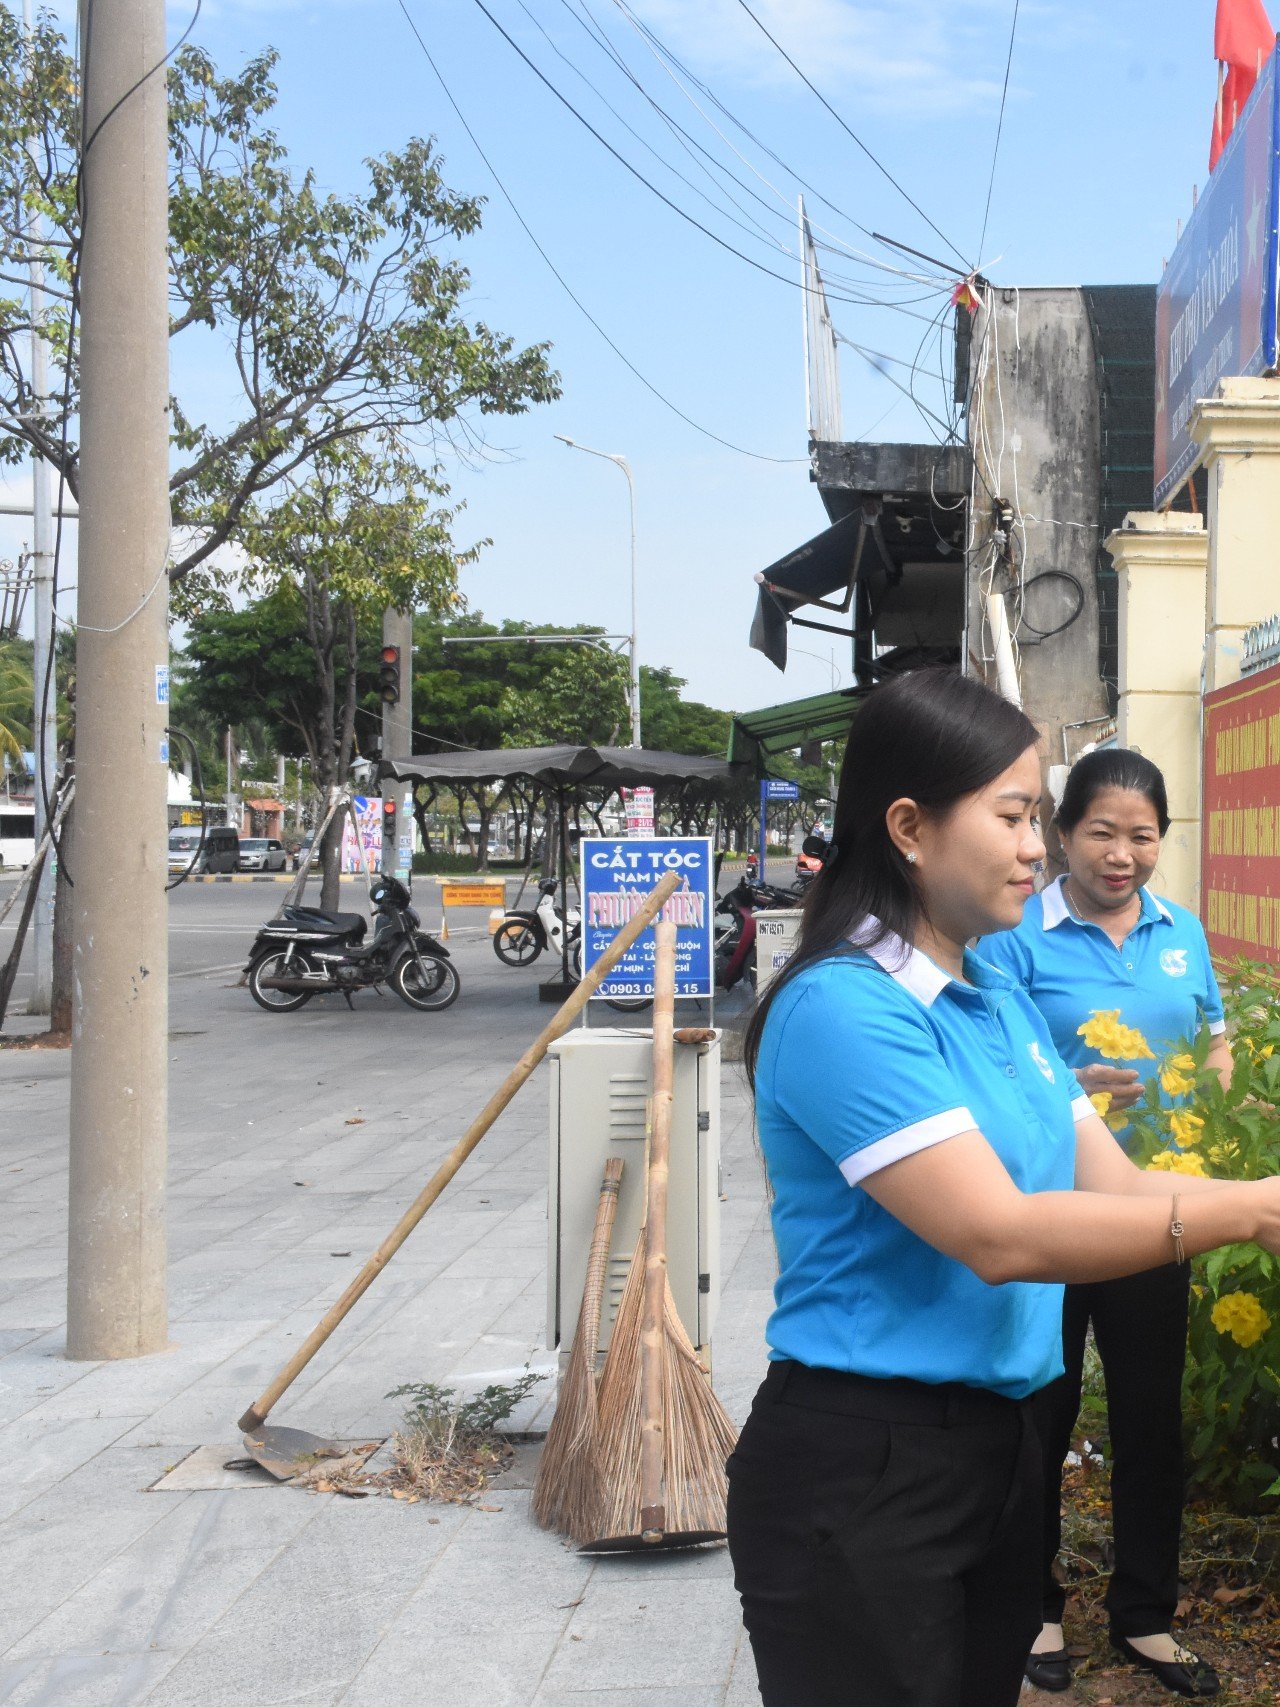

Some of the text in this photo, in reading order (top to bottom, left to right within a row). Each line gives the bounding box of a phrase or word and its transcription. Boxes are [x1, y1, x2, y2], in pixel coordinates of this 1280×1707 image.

[591, 845, 702, 868] CẮT TÓC
[613, 872, 650, 883] NAM
[642, 940, 656, 951] GỘ
[675, 942, 701, 951] HUỘM
[622, 953, 637, 961] TAI
[623, 965, 644, 974] MỤN
[609, 983, 641, 994] 0903
[683, 983, 698, 994] 15
